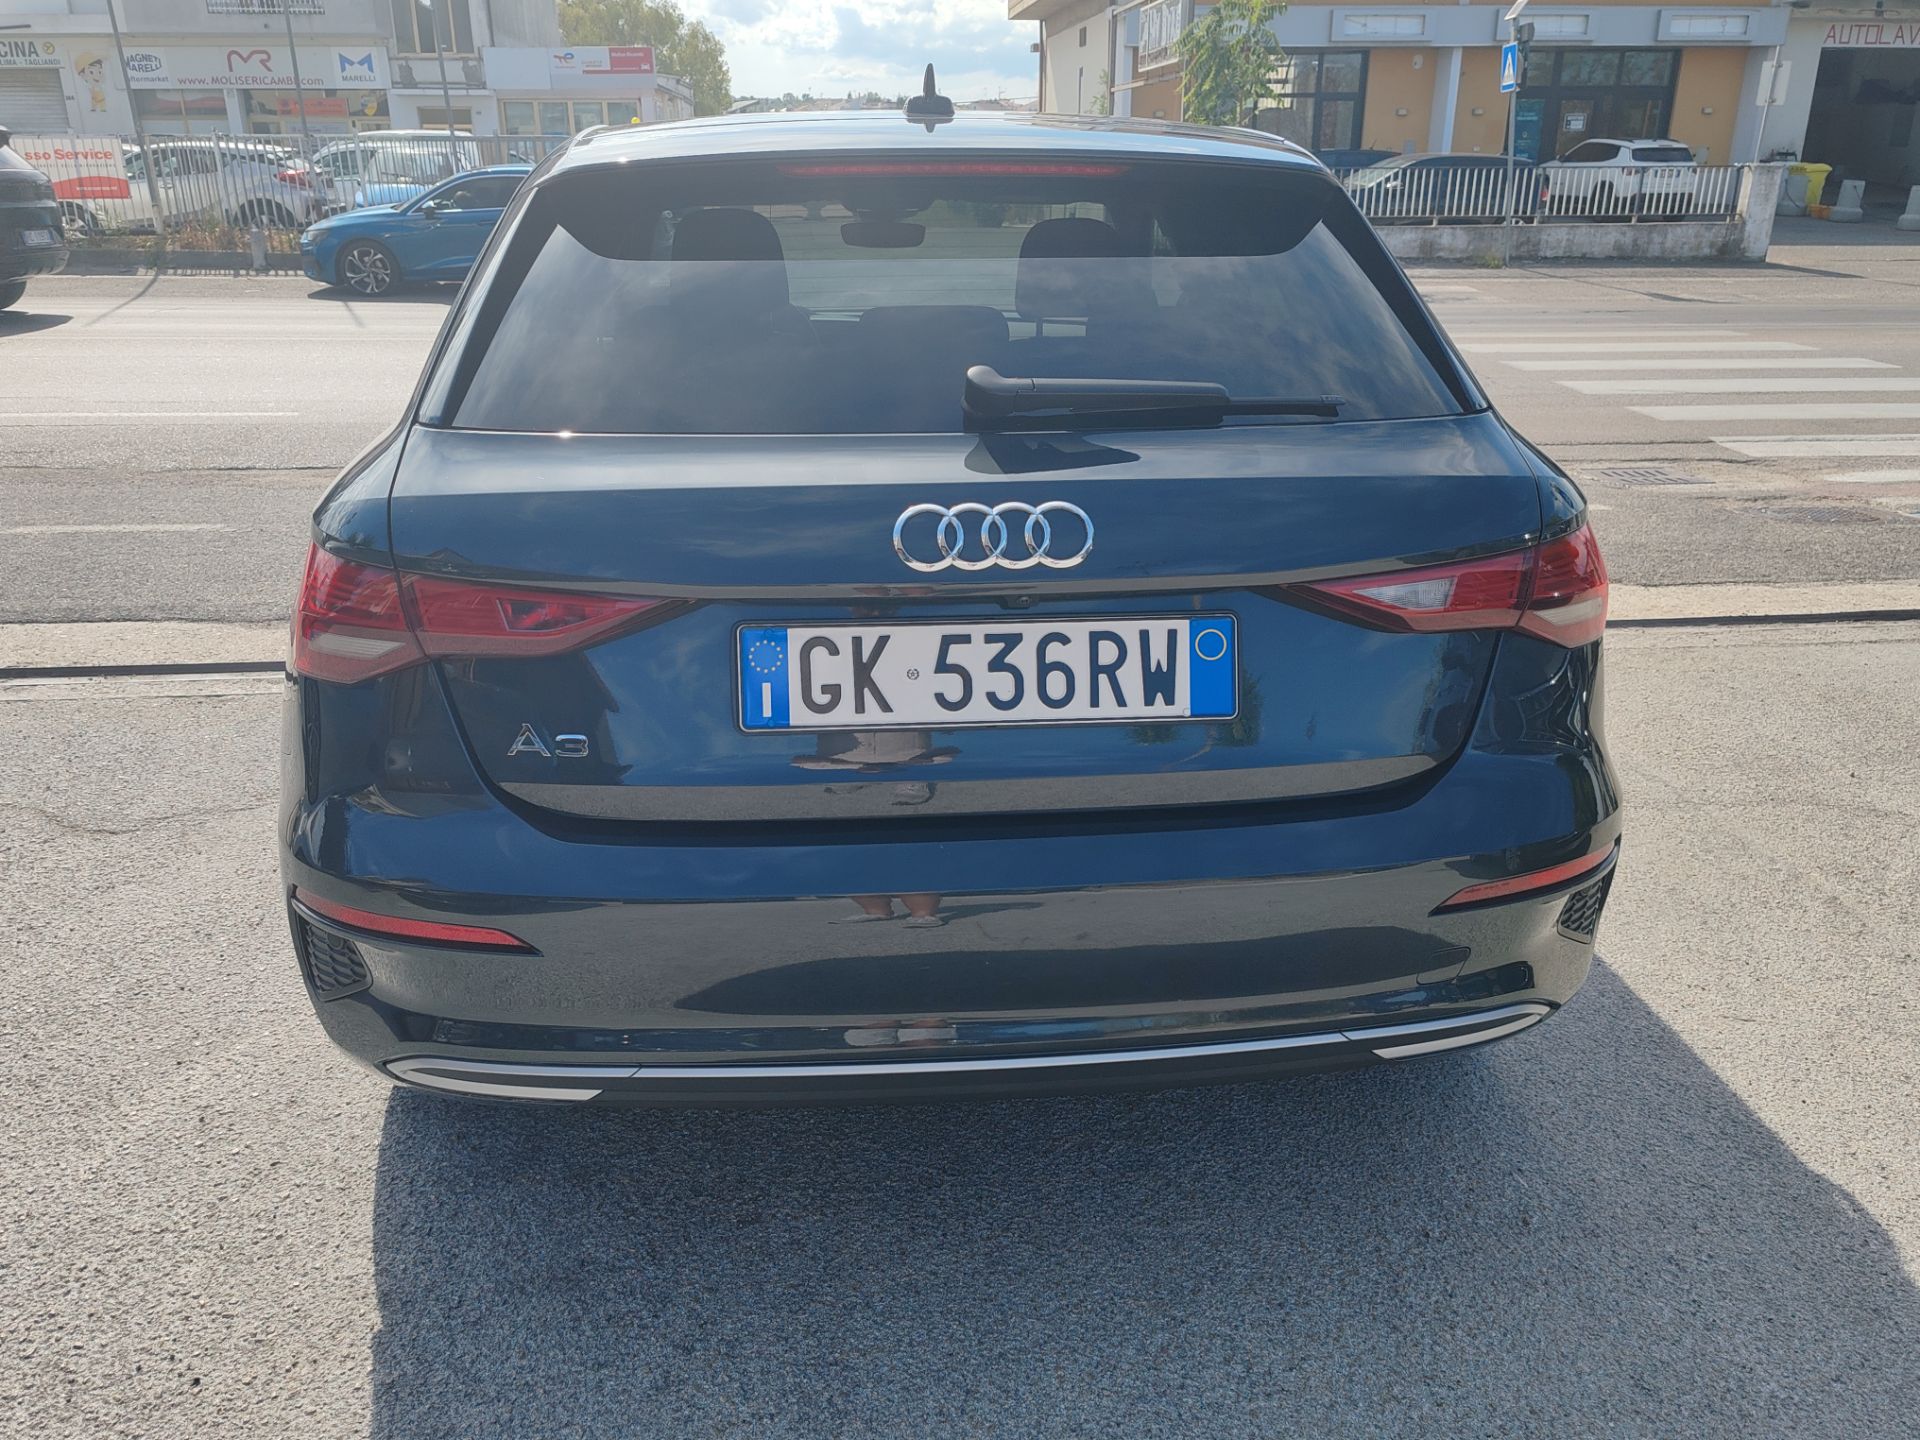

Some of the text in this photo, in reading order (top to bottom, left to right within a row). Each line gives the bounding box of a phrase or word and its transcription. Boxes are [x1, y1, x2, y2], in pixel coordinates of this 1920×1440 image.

[1823, 24, 1920, 45] AUTOLAV
[0, 41, 40, 58] CINA
[177, 75, 324, 87] www.MOLISERICAMBIcom
[24, 148, 113, 161] sso Service
[799, 634, 895, 715] GK
[932, 628, 1179, 712] 536RW
[507, 723, 589, 758] A3
